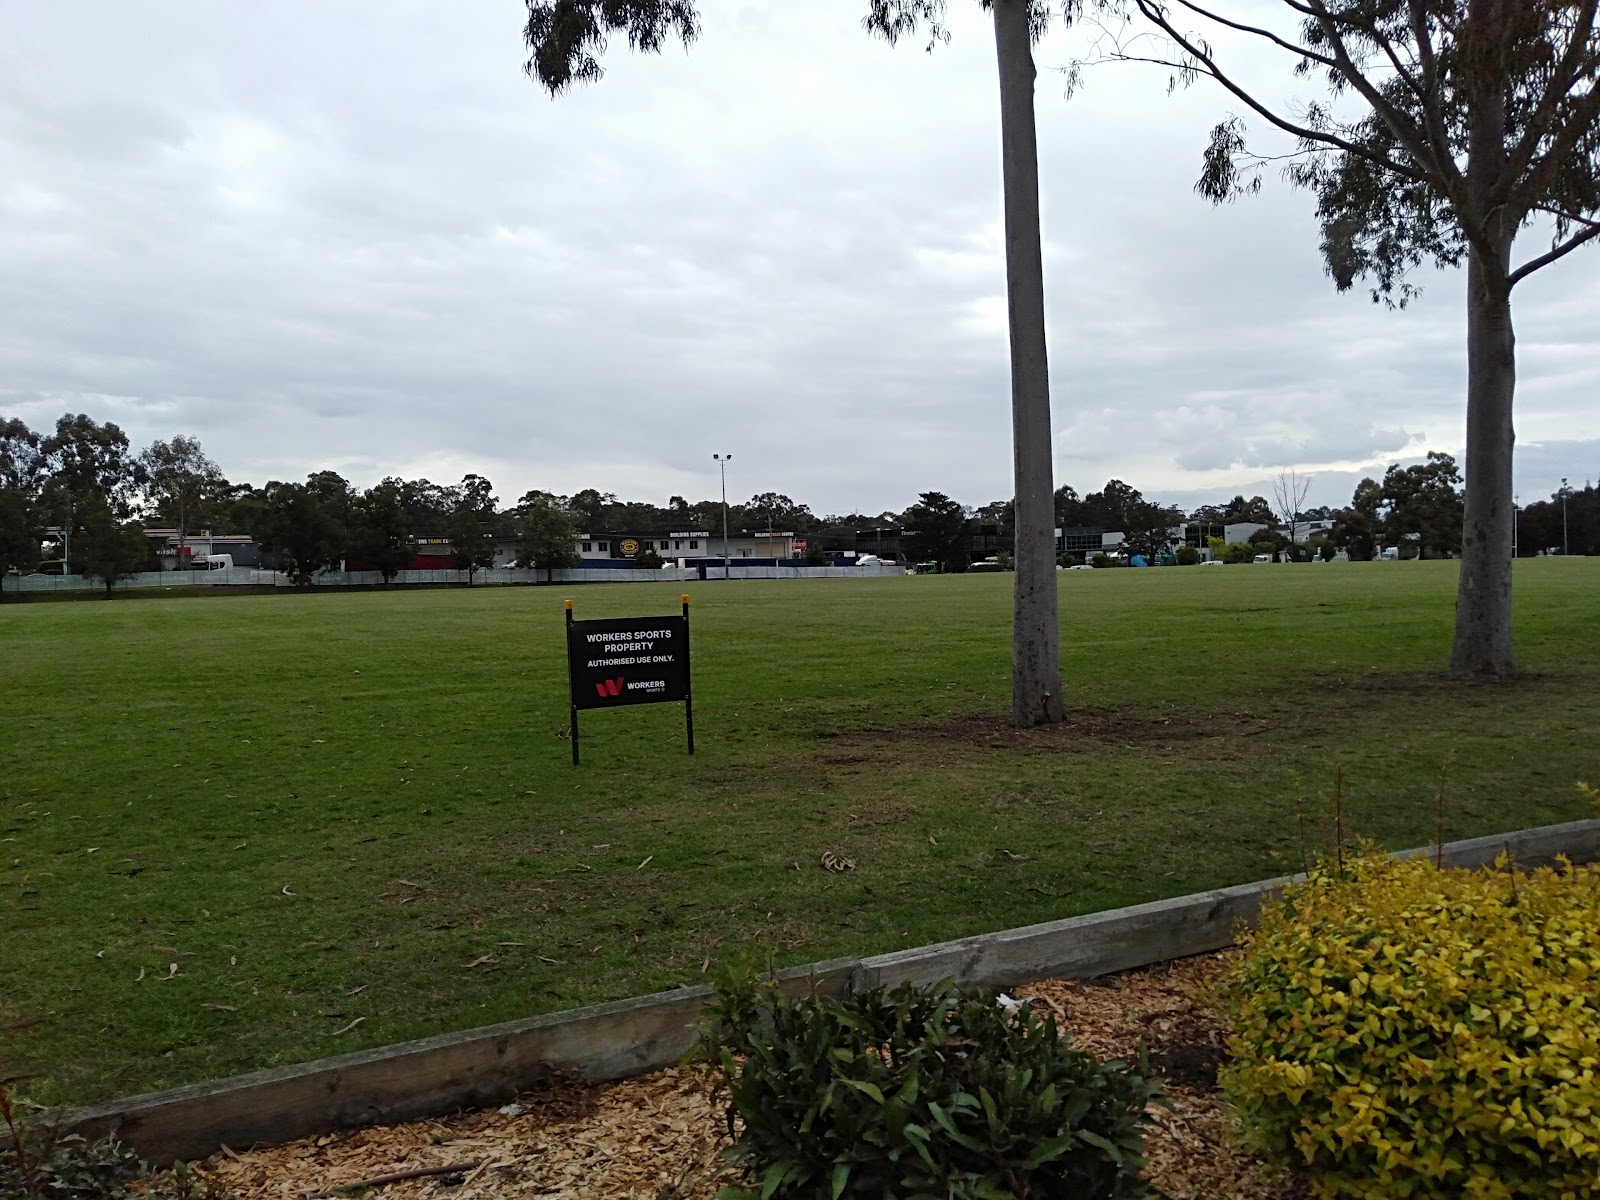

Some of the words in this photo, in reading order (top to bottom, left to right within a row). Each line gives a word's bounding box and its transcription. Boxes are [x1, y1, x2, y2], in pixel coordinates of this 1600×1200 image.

[586, 631, 633, 643] WORKERS
[633, 629, 672, 640] SPORTS
[604, 641, 654, 653] PROPERTY
[587, 657, 636, 668] AUTHORISED
[636, 656, 652, 664] USE
[652, 654, 675, 663] ONLY.
[627, 680, 665, 690] WORKERS
